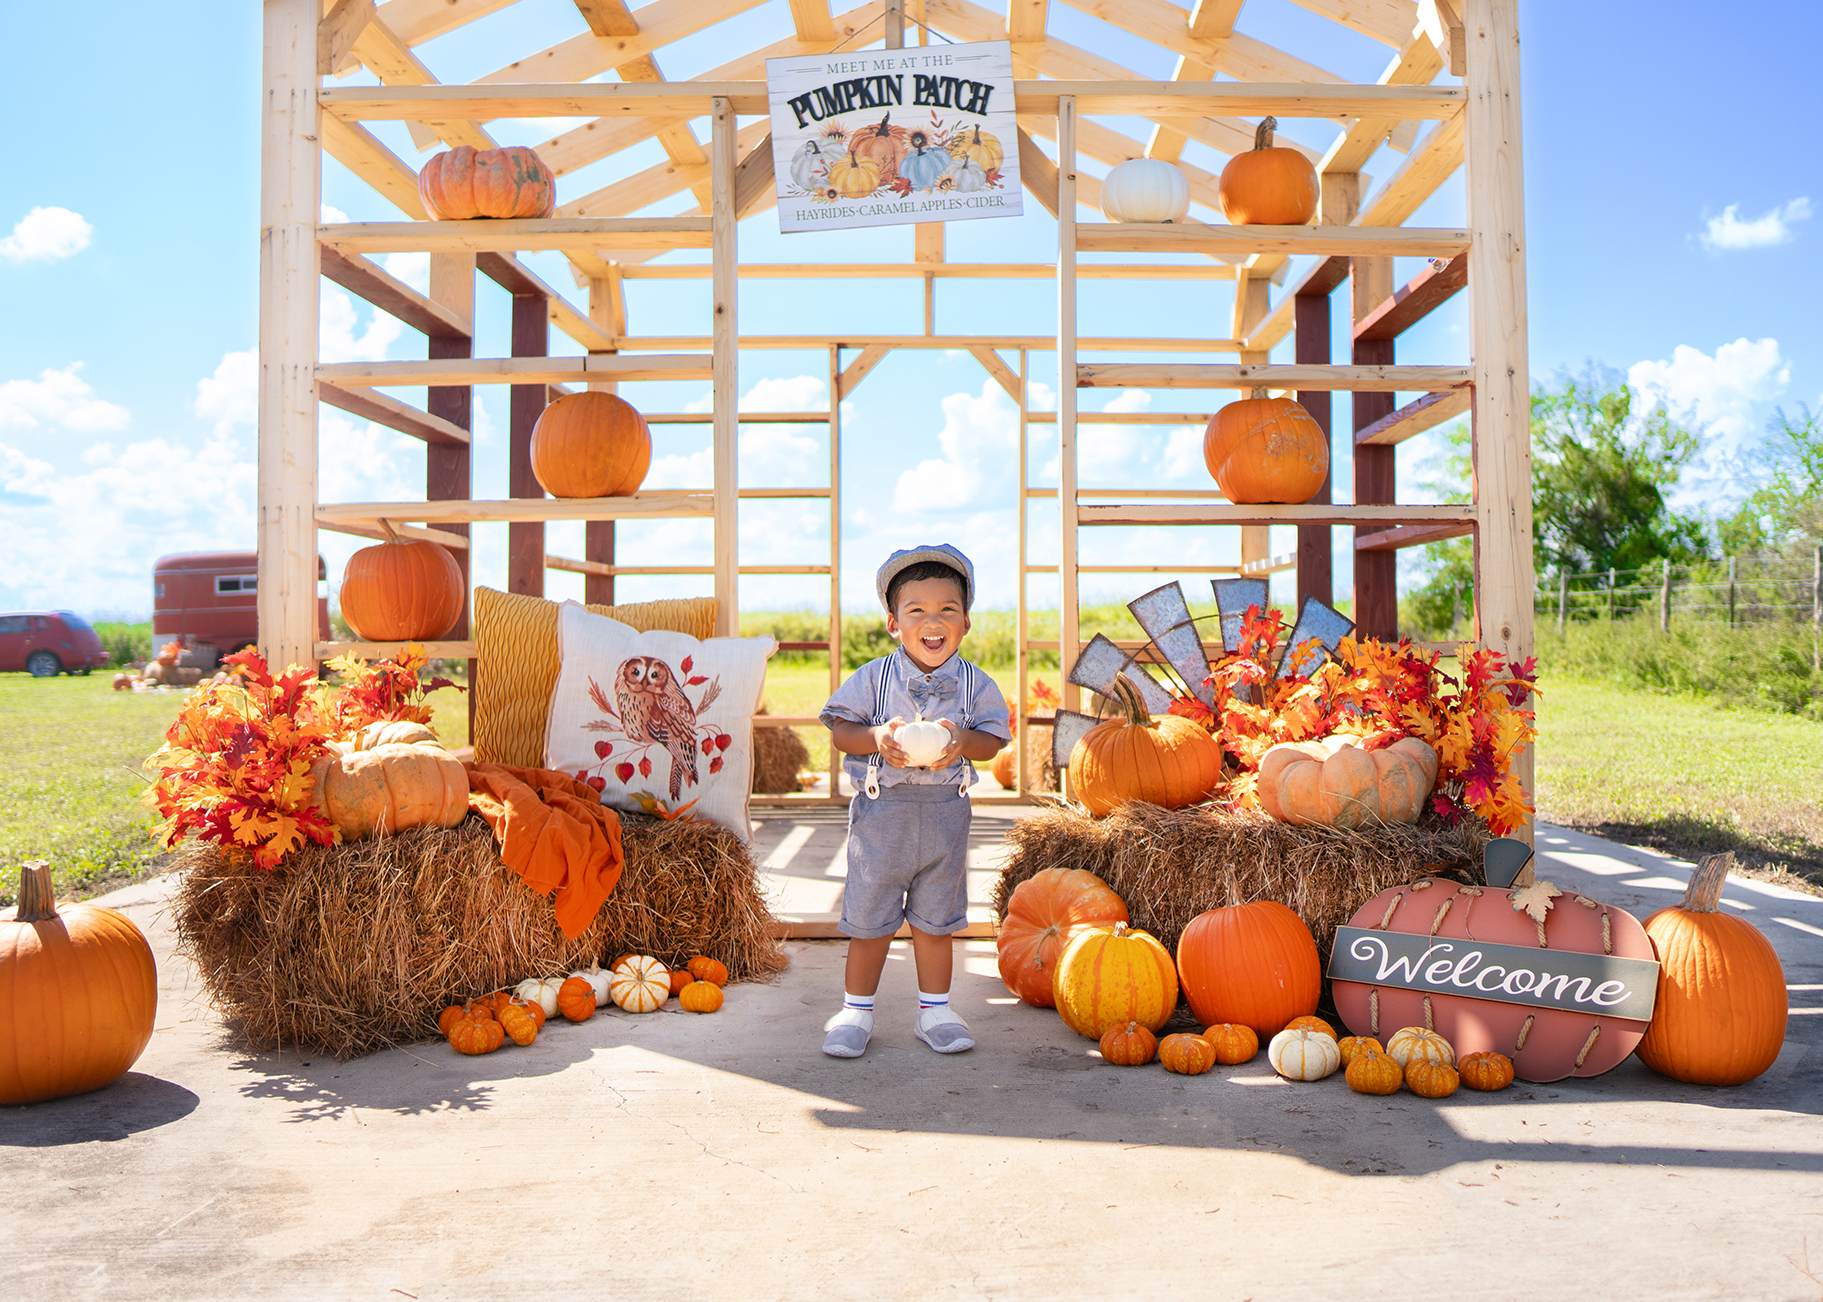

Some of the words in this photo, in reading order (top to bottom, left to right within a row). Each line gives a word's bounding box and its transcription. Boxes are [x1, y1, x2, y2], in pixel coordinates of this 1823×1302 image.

[826, 60, 868, 74] MEET
[873, 59, 895, 72] ME
[900, 57, 918, 69] AT
[922, 54, 954, 67] THE
[787, 74, 904, 129] PUMPKIN
[912, 74, 995, 116] PATCH
[1350, 936, 1632, 1006] Welcome
